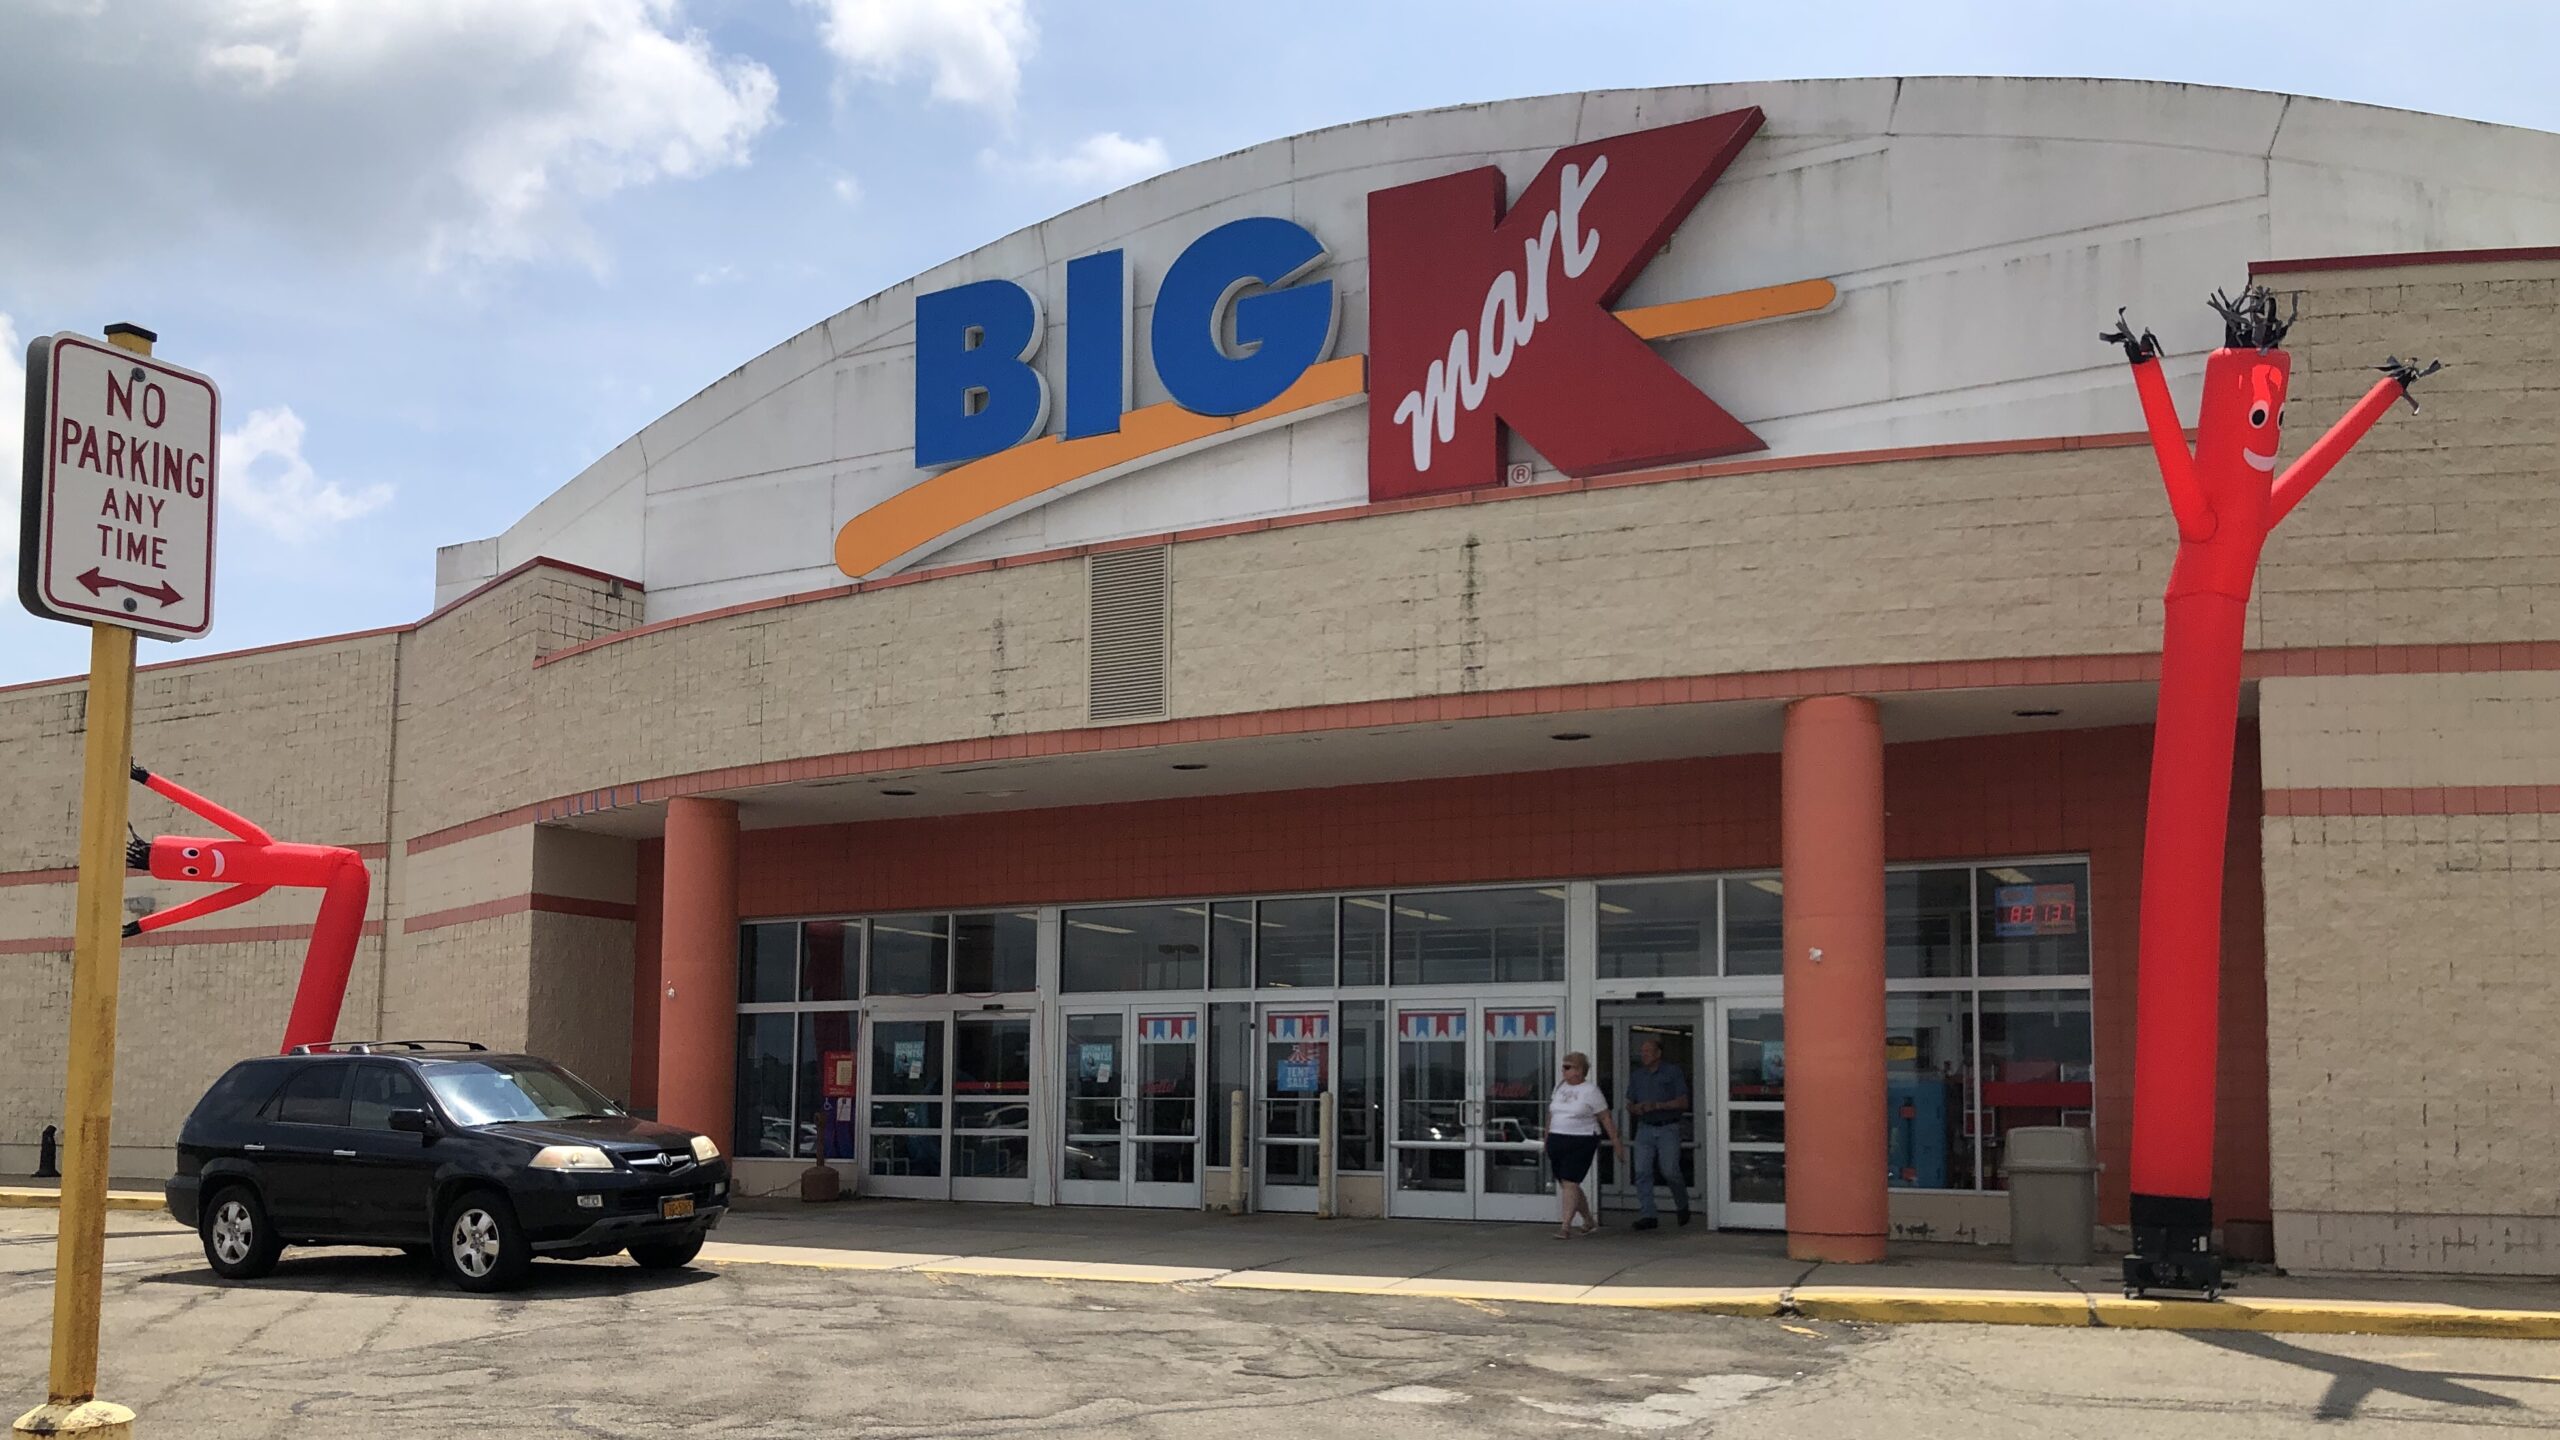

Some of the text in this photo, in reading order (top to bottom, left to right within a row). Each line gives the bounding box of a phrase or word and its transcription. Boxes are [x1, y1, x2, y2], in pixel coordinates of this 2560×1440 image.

[915, 105, 1769, 499] BIG K
[1393, 154, 1608, 472] mart
[106, 369, 166, 430] NO
[60, 417, 205, 499] PARKING
[101, 487, 165, 529] ANY
[97, 523, 168, 570] TIME
[1287, 1077, 1310, 1088] SALE
